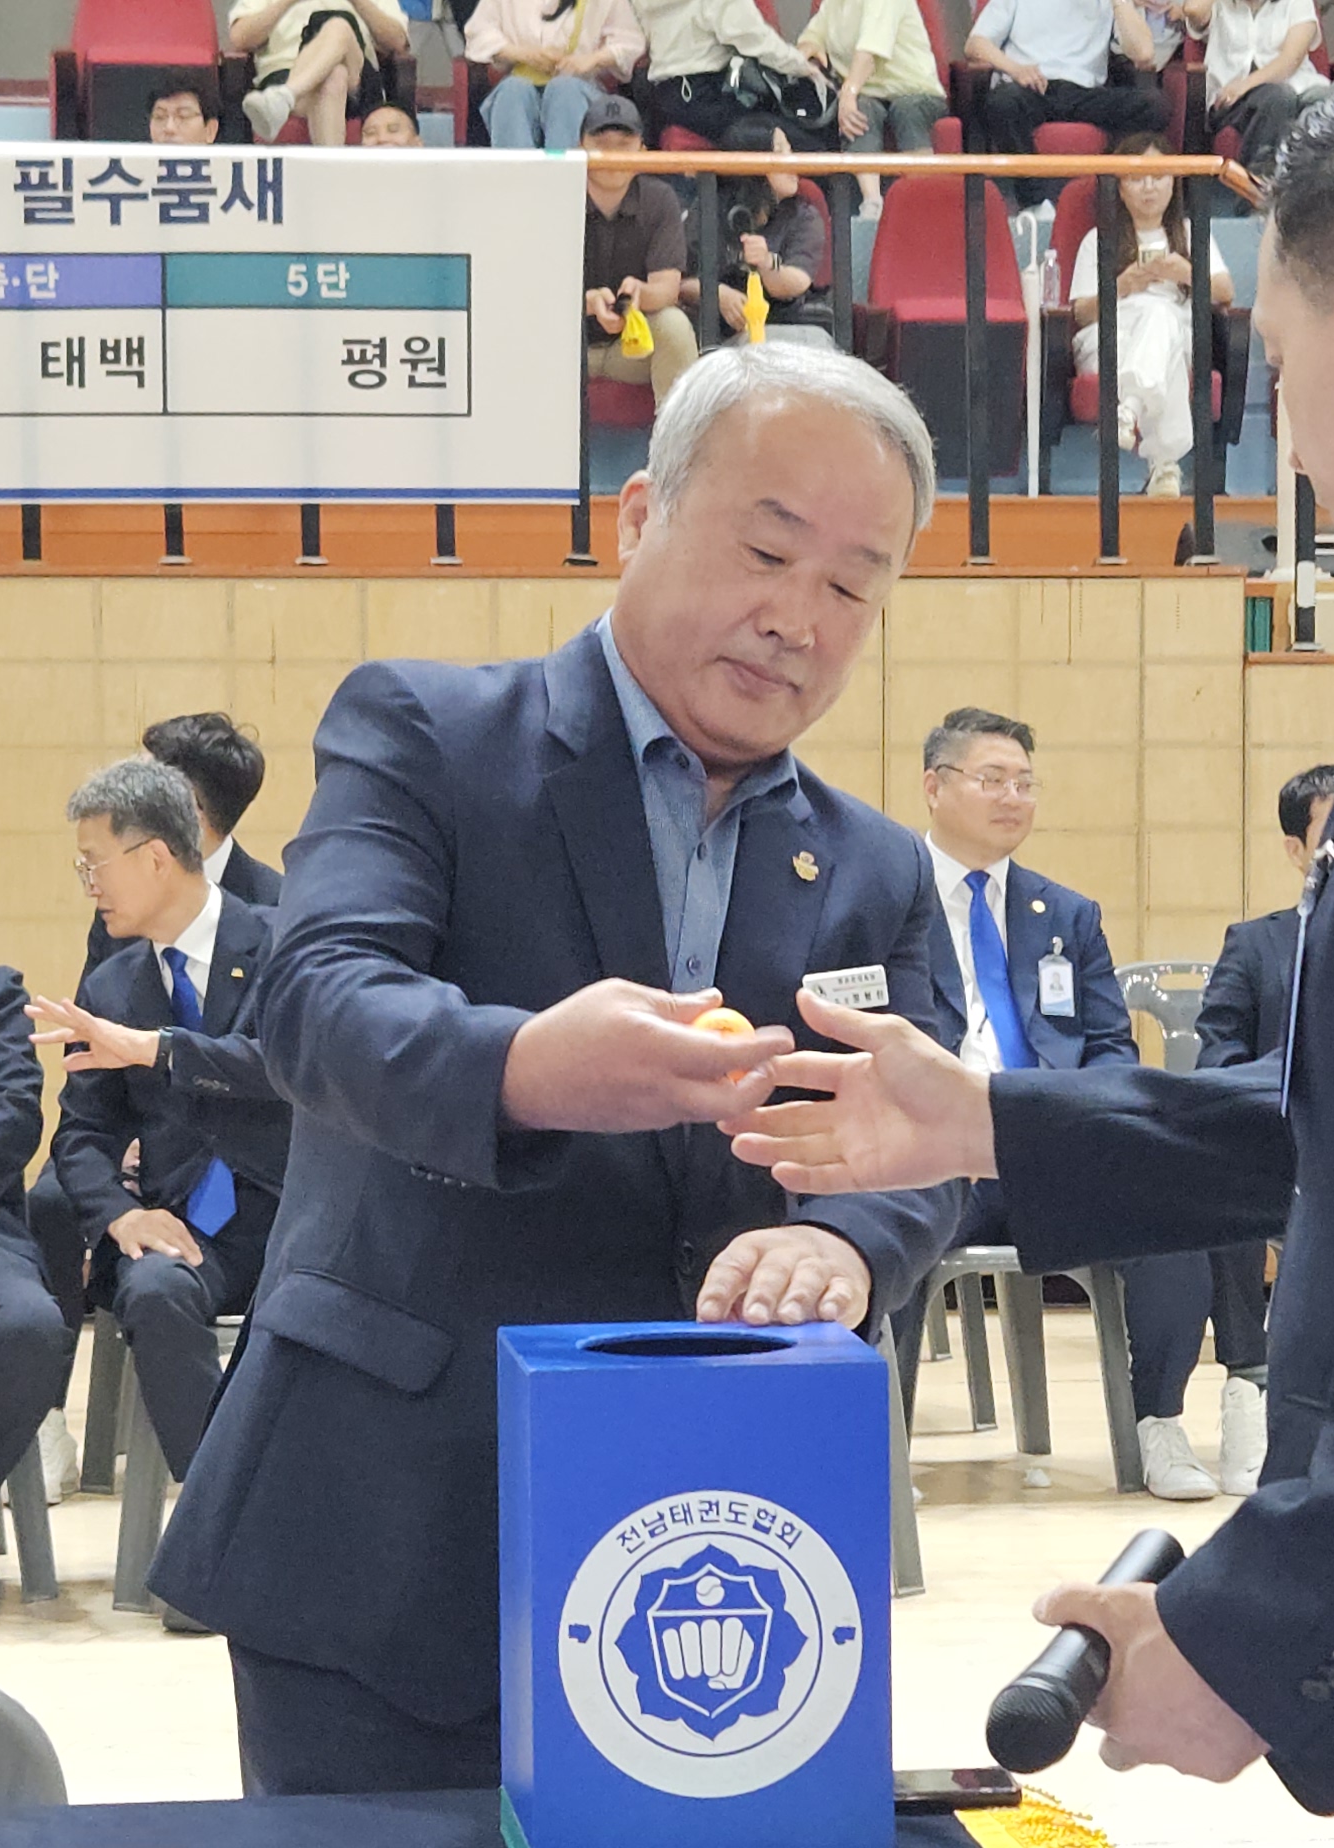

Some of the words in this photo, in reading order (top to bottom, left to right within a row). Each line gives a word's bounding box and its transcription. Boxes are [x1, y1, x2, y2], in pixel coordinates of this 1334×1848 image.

[13, 157, 283, 226] 필수품새
[287, 262, 350, 299] 5단
[40, 336, 146, 389] 태백
[341, 337, 447, 390] 평원
[616, 1499, 803, 1555] 전남태권도협회
